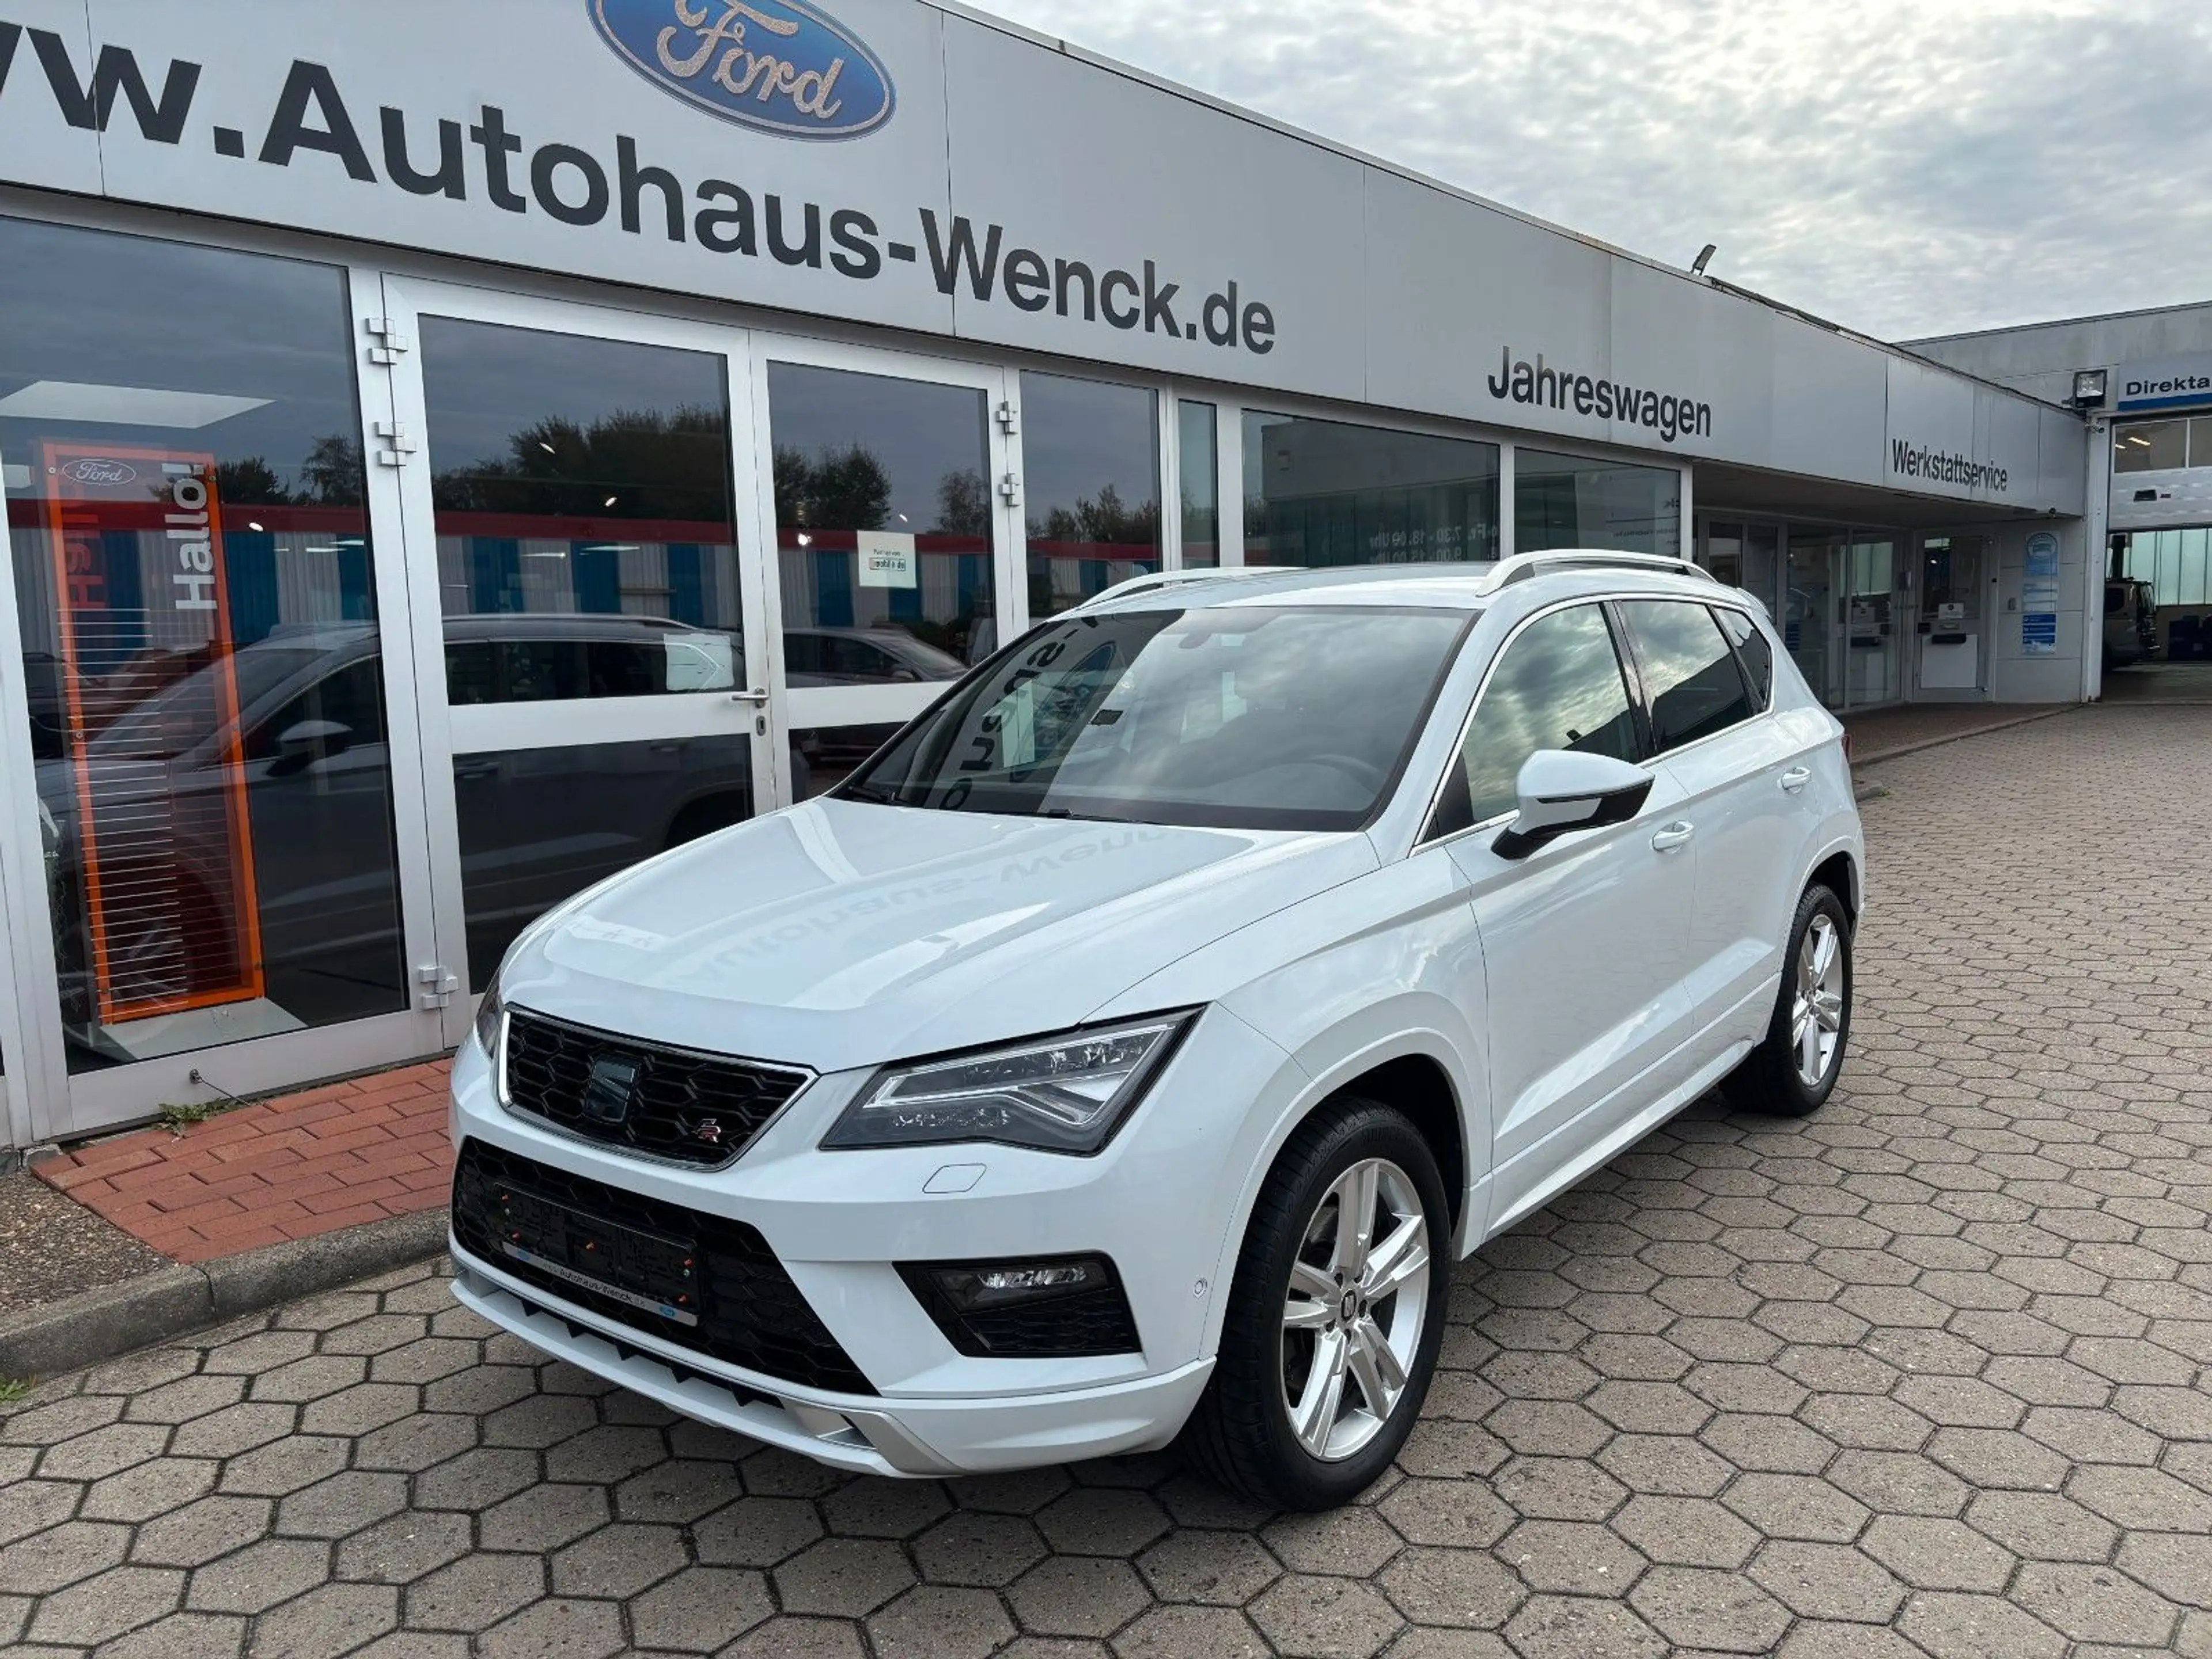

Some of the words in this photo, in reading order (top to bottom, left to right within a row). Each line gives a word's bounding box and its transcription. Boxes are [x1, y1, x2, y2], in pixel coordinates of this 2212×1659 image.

[657, 0, 844, 119] Ford
[0, 20, 1275, 355] w.Autohaus-Wenck.de
[1488, 345, 1711, 443] Jahreswagen
[2126, 376, 2210, 396] Direkta
[75, 462, 123, 481] Ford
[1892, 438, 2008, 491] Werkstattservice
[161, 463, 218, 609] Hallo!
